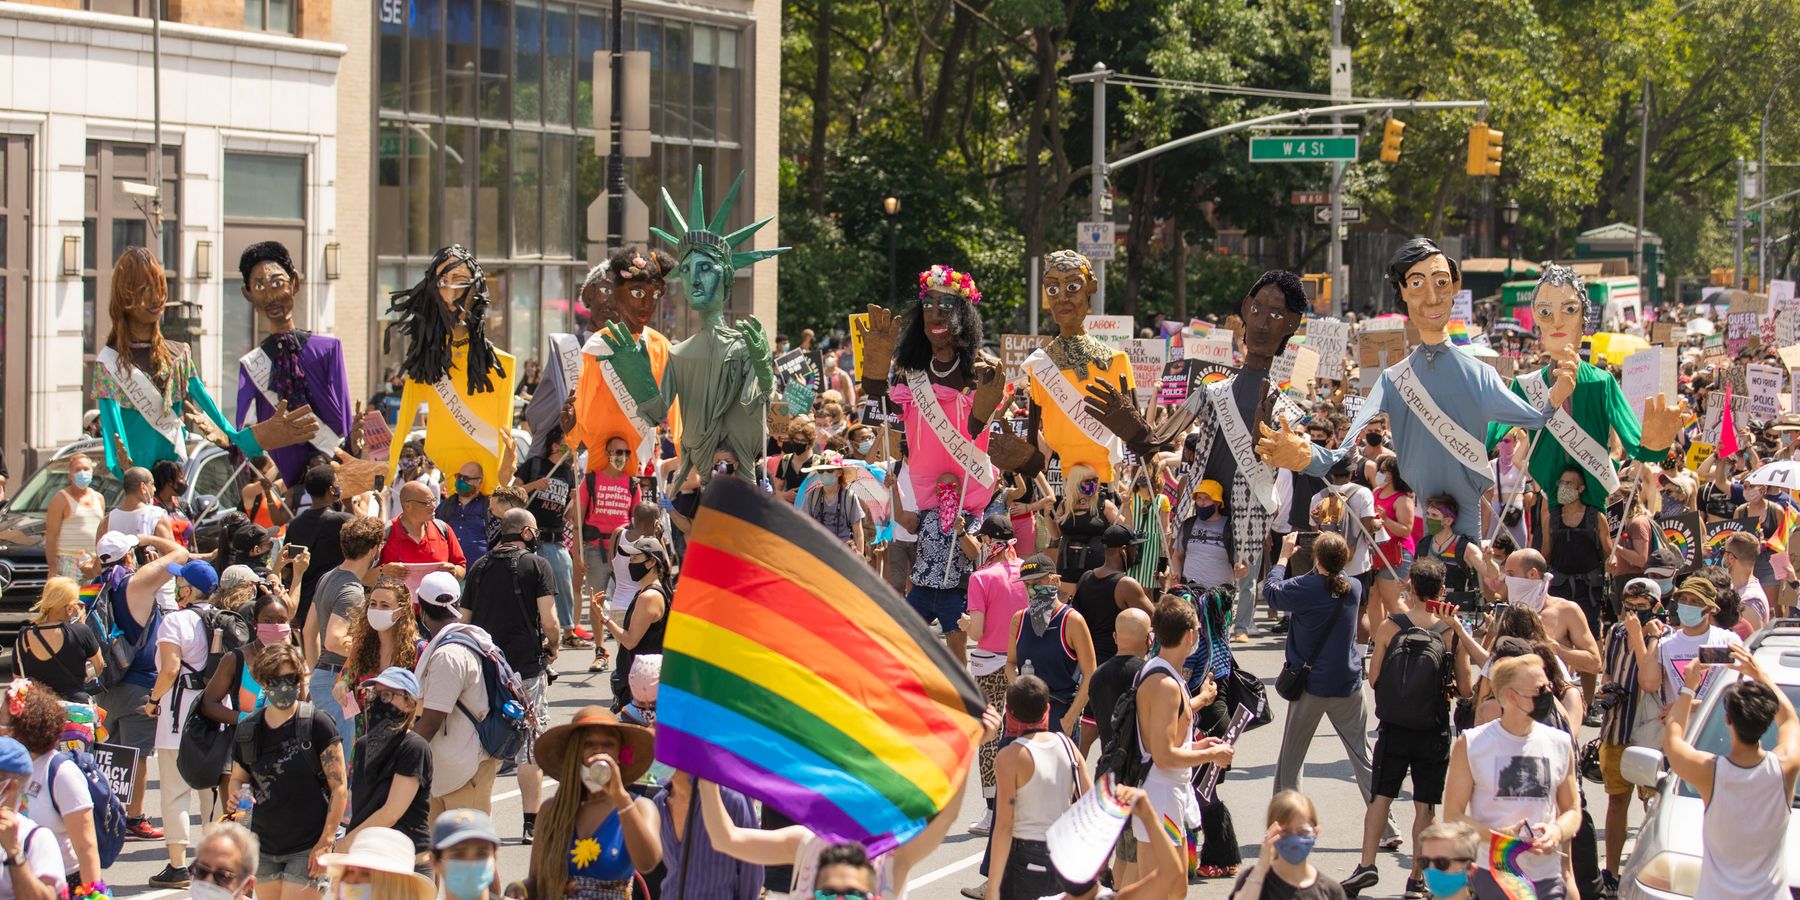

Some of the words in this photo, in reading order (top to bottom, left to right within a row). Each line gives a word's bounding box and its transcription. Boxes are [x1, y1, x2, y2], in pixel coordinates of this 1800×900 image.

[380, 0, 402, 24] SE
[1283, 142, 1293, 156] W
[1297, 142, 1306, 156] 4
[1311, 141, 1325, 156] St
[1083, 224, 1109, 232] NYPD
[1089, 320, 1120, 330] LABOR:
[1728, 313, 1756, 324] QUEER
[1309, 320, 1342, 337] BLACK
[1005, 336, 1044, 350] BLACK
[1308, 335, 1342, 353] TRANS
[1124, 347, 1145, 356] BLACK
[1213, 344, 1228, 357] OUT
[1130, 355, 1161, 363] BERATION
[1320, 350, 1339, 367] VES
[1036, 364, 1069, 404] Alice
[1752, 378, 1762, 386] NO
[1161, 388, 1183, 396] POLICE
[1753, 394, 1775, 406] POLICE
[446, 394, 477, 436] Rivera
[1213, 386, 1235, 433] Simon
[1393, 367, 1442, 426] Raymond
[1438, 422, 1480, 463] Castro
[876, 413, 901, 424] HUANITY
[908, 373, 937, 423] Marsha
[935, 418, 949, 432] P
[942, 429, 986, 480] Johnon
[1698, 447, 1709, 455] End
[1768, 469, 1790, 483] M
[607, 485, 629, 494] migra
[1723, 520, 1744, 531] LIVES
[1661, 519, 1685, 531] LIVES
[1681, 527, 1697, 568] MATTER
